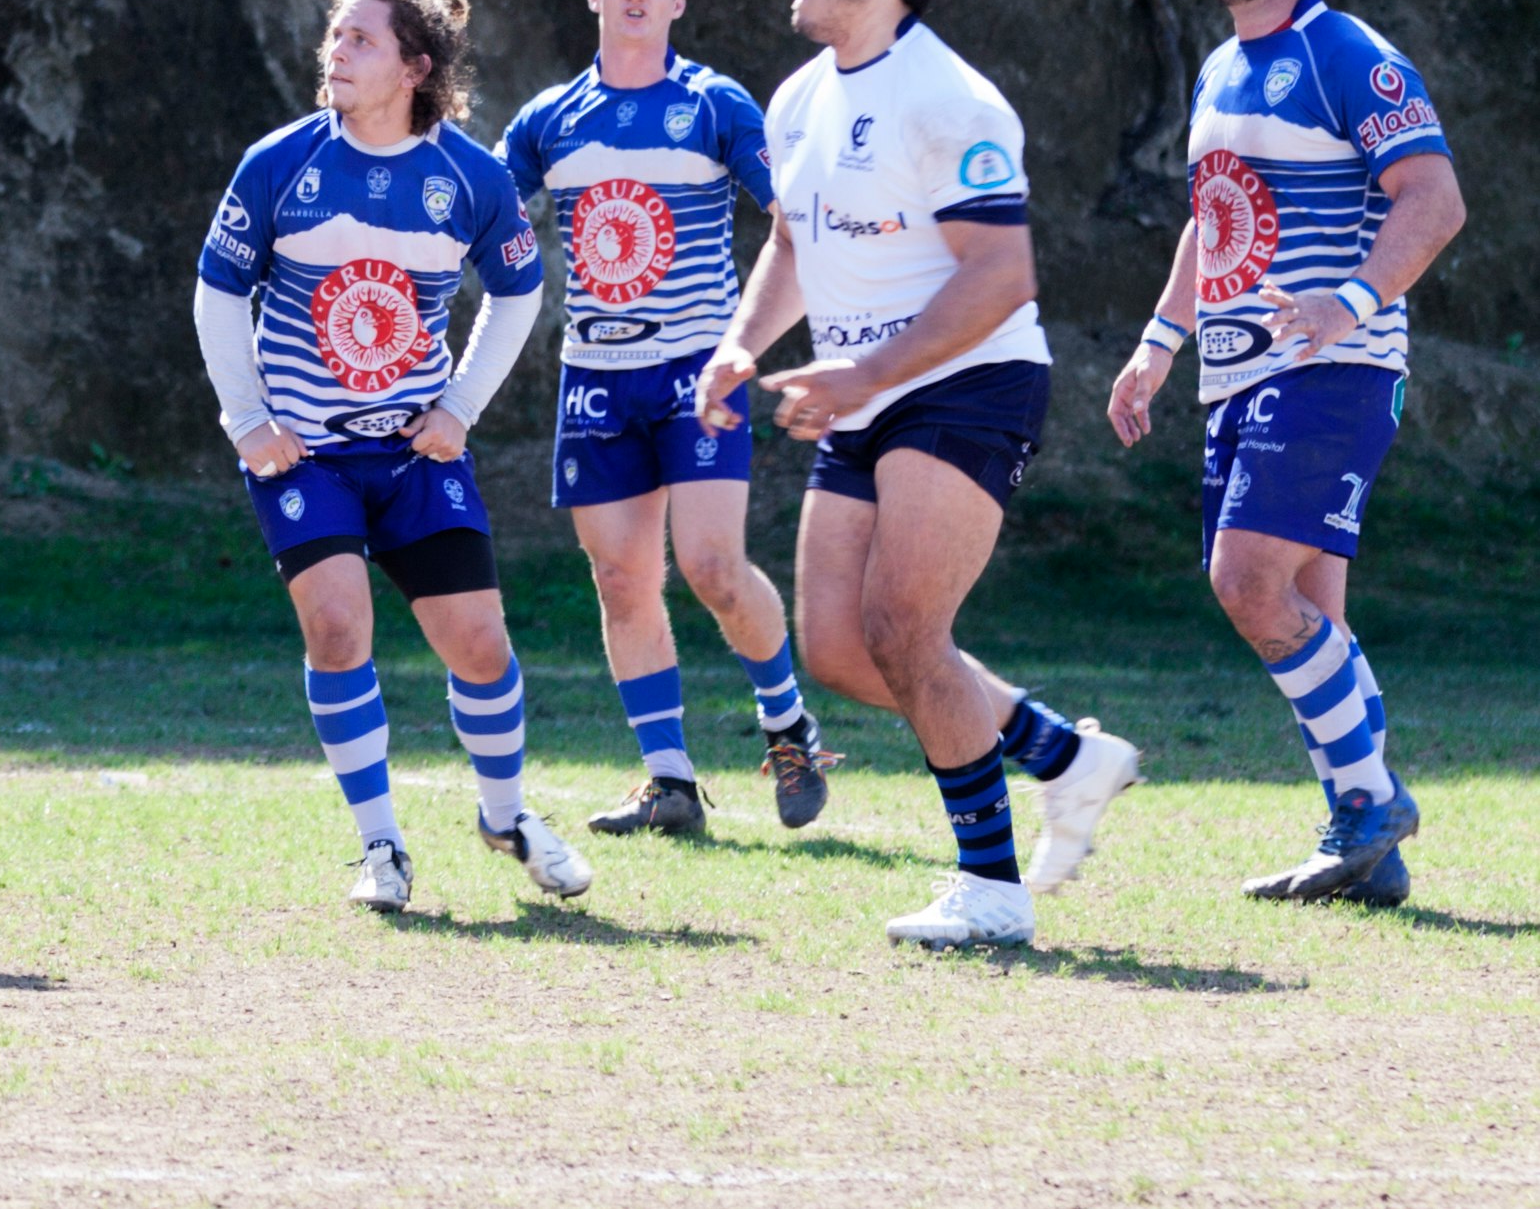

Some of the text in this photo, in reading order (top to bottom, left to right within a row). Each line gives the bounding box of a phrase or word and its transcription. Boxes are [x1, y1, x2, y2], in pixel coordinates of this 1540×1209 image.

[281, 209, 333, 218] MARBELLA
[577, 180, 665, 218] GRUPO
[566, 385, 609, 419] HC
